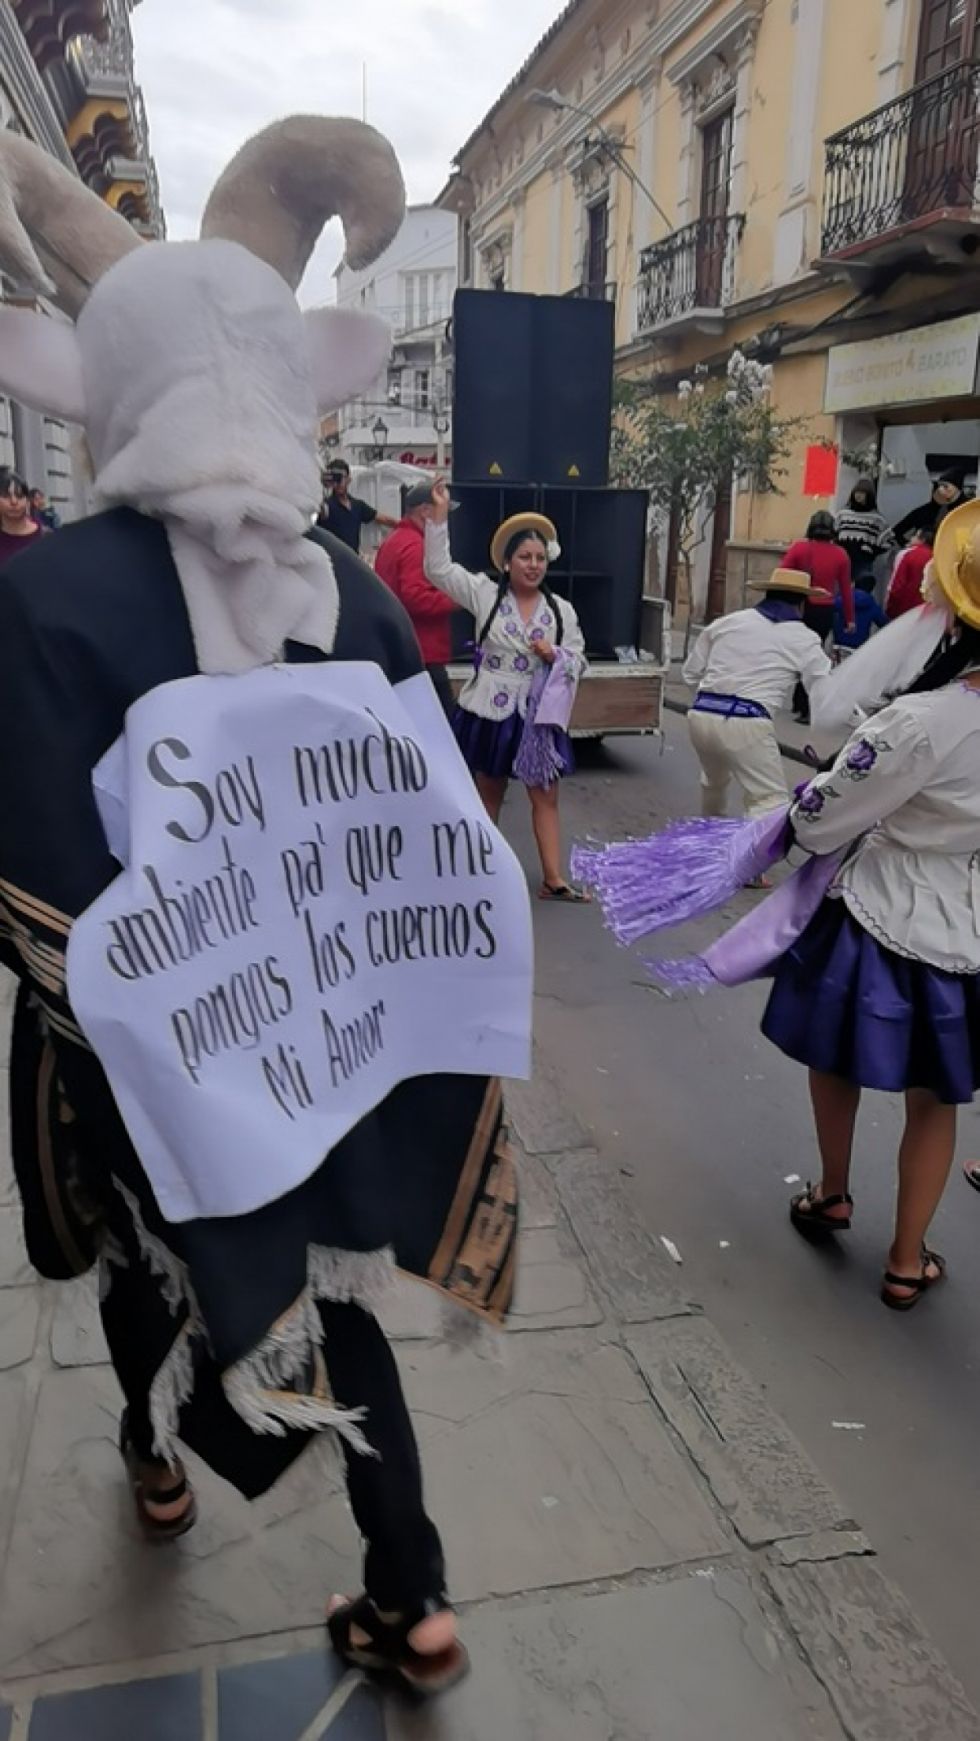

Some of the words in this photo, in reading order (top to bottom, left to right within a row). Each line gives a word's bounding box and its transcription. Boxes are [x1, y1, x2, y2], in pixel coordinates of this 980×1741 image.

[918, 346, 967, 371] BARATO
[146, 736, 266, 843] Soy
[292, 706, 429, 807] mucho
[105, 835, 260, 980] ambiente
[345, 823, 403, 896] que
[432, 817, 497, 879] me
[170, 955, 293, 1085] pongas
[303, 908, 356, 994] los
[365, 899, 497, 968] cuernos
[261, 1043, 314, 1121] Mi
[320, 999, 387, 1089] Amor
